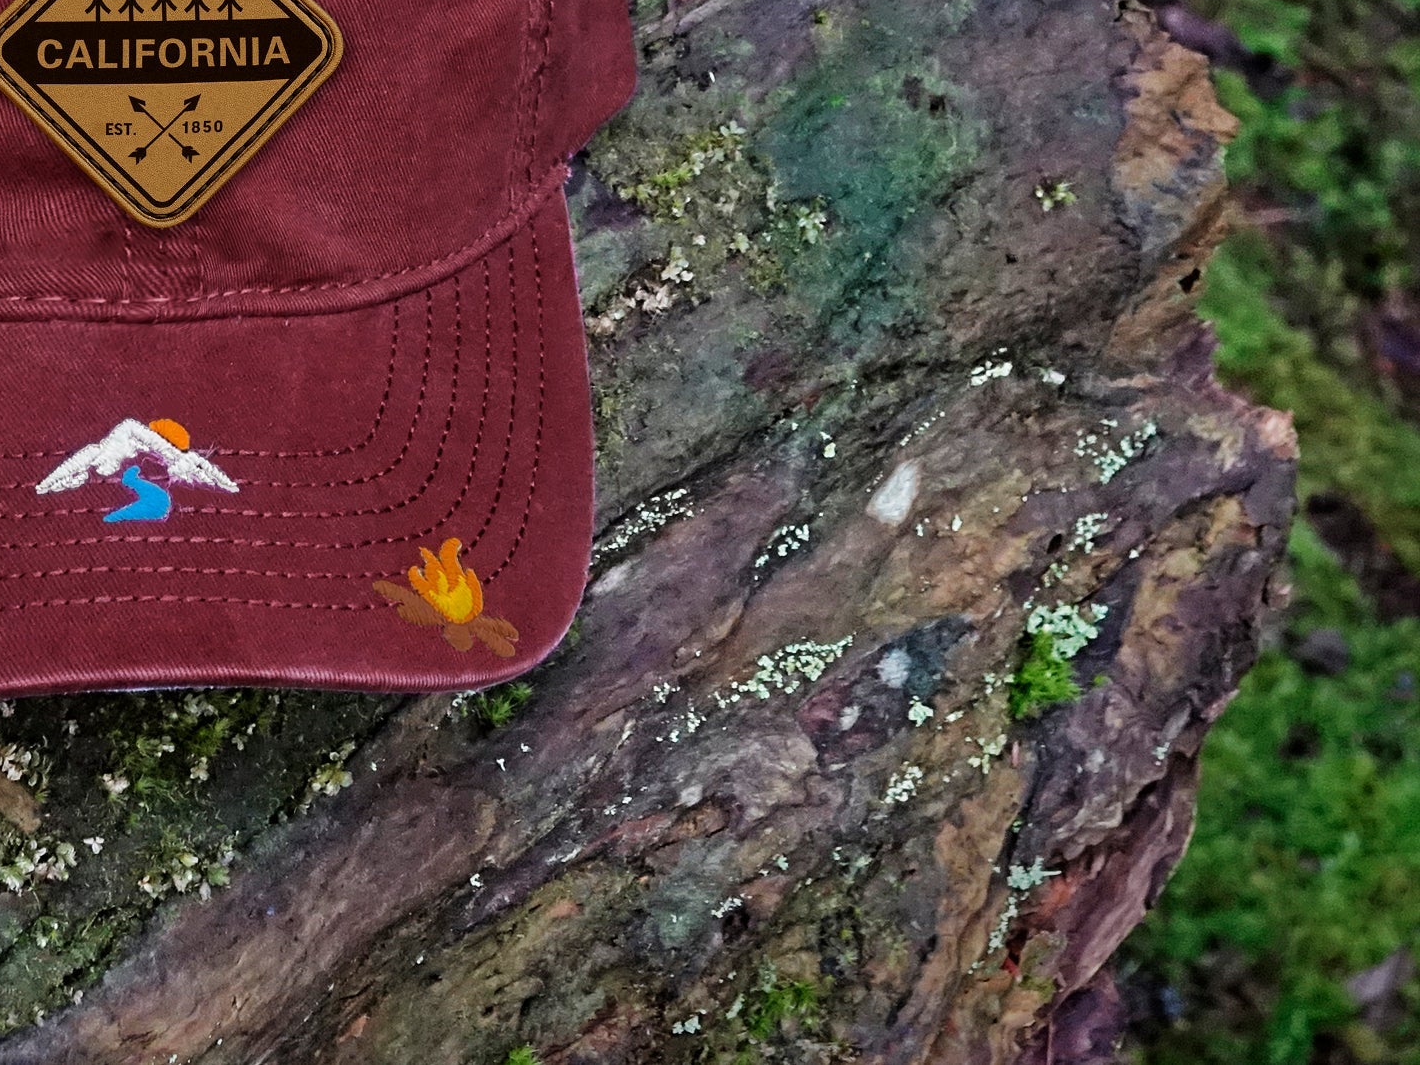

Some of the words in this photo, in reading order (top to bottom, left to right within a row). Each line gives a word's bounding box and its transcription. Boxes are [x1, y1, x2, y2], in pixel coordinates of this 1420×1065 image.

[37, 36, 291, 69] CALIFORNIA
[105, 122, 137, 136] EST.
[182, 120, 223, 134] 1850
